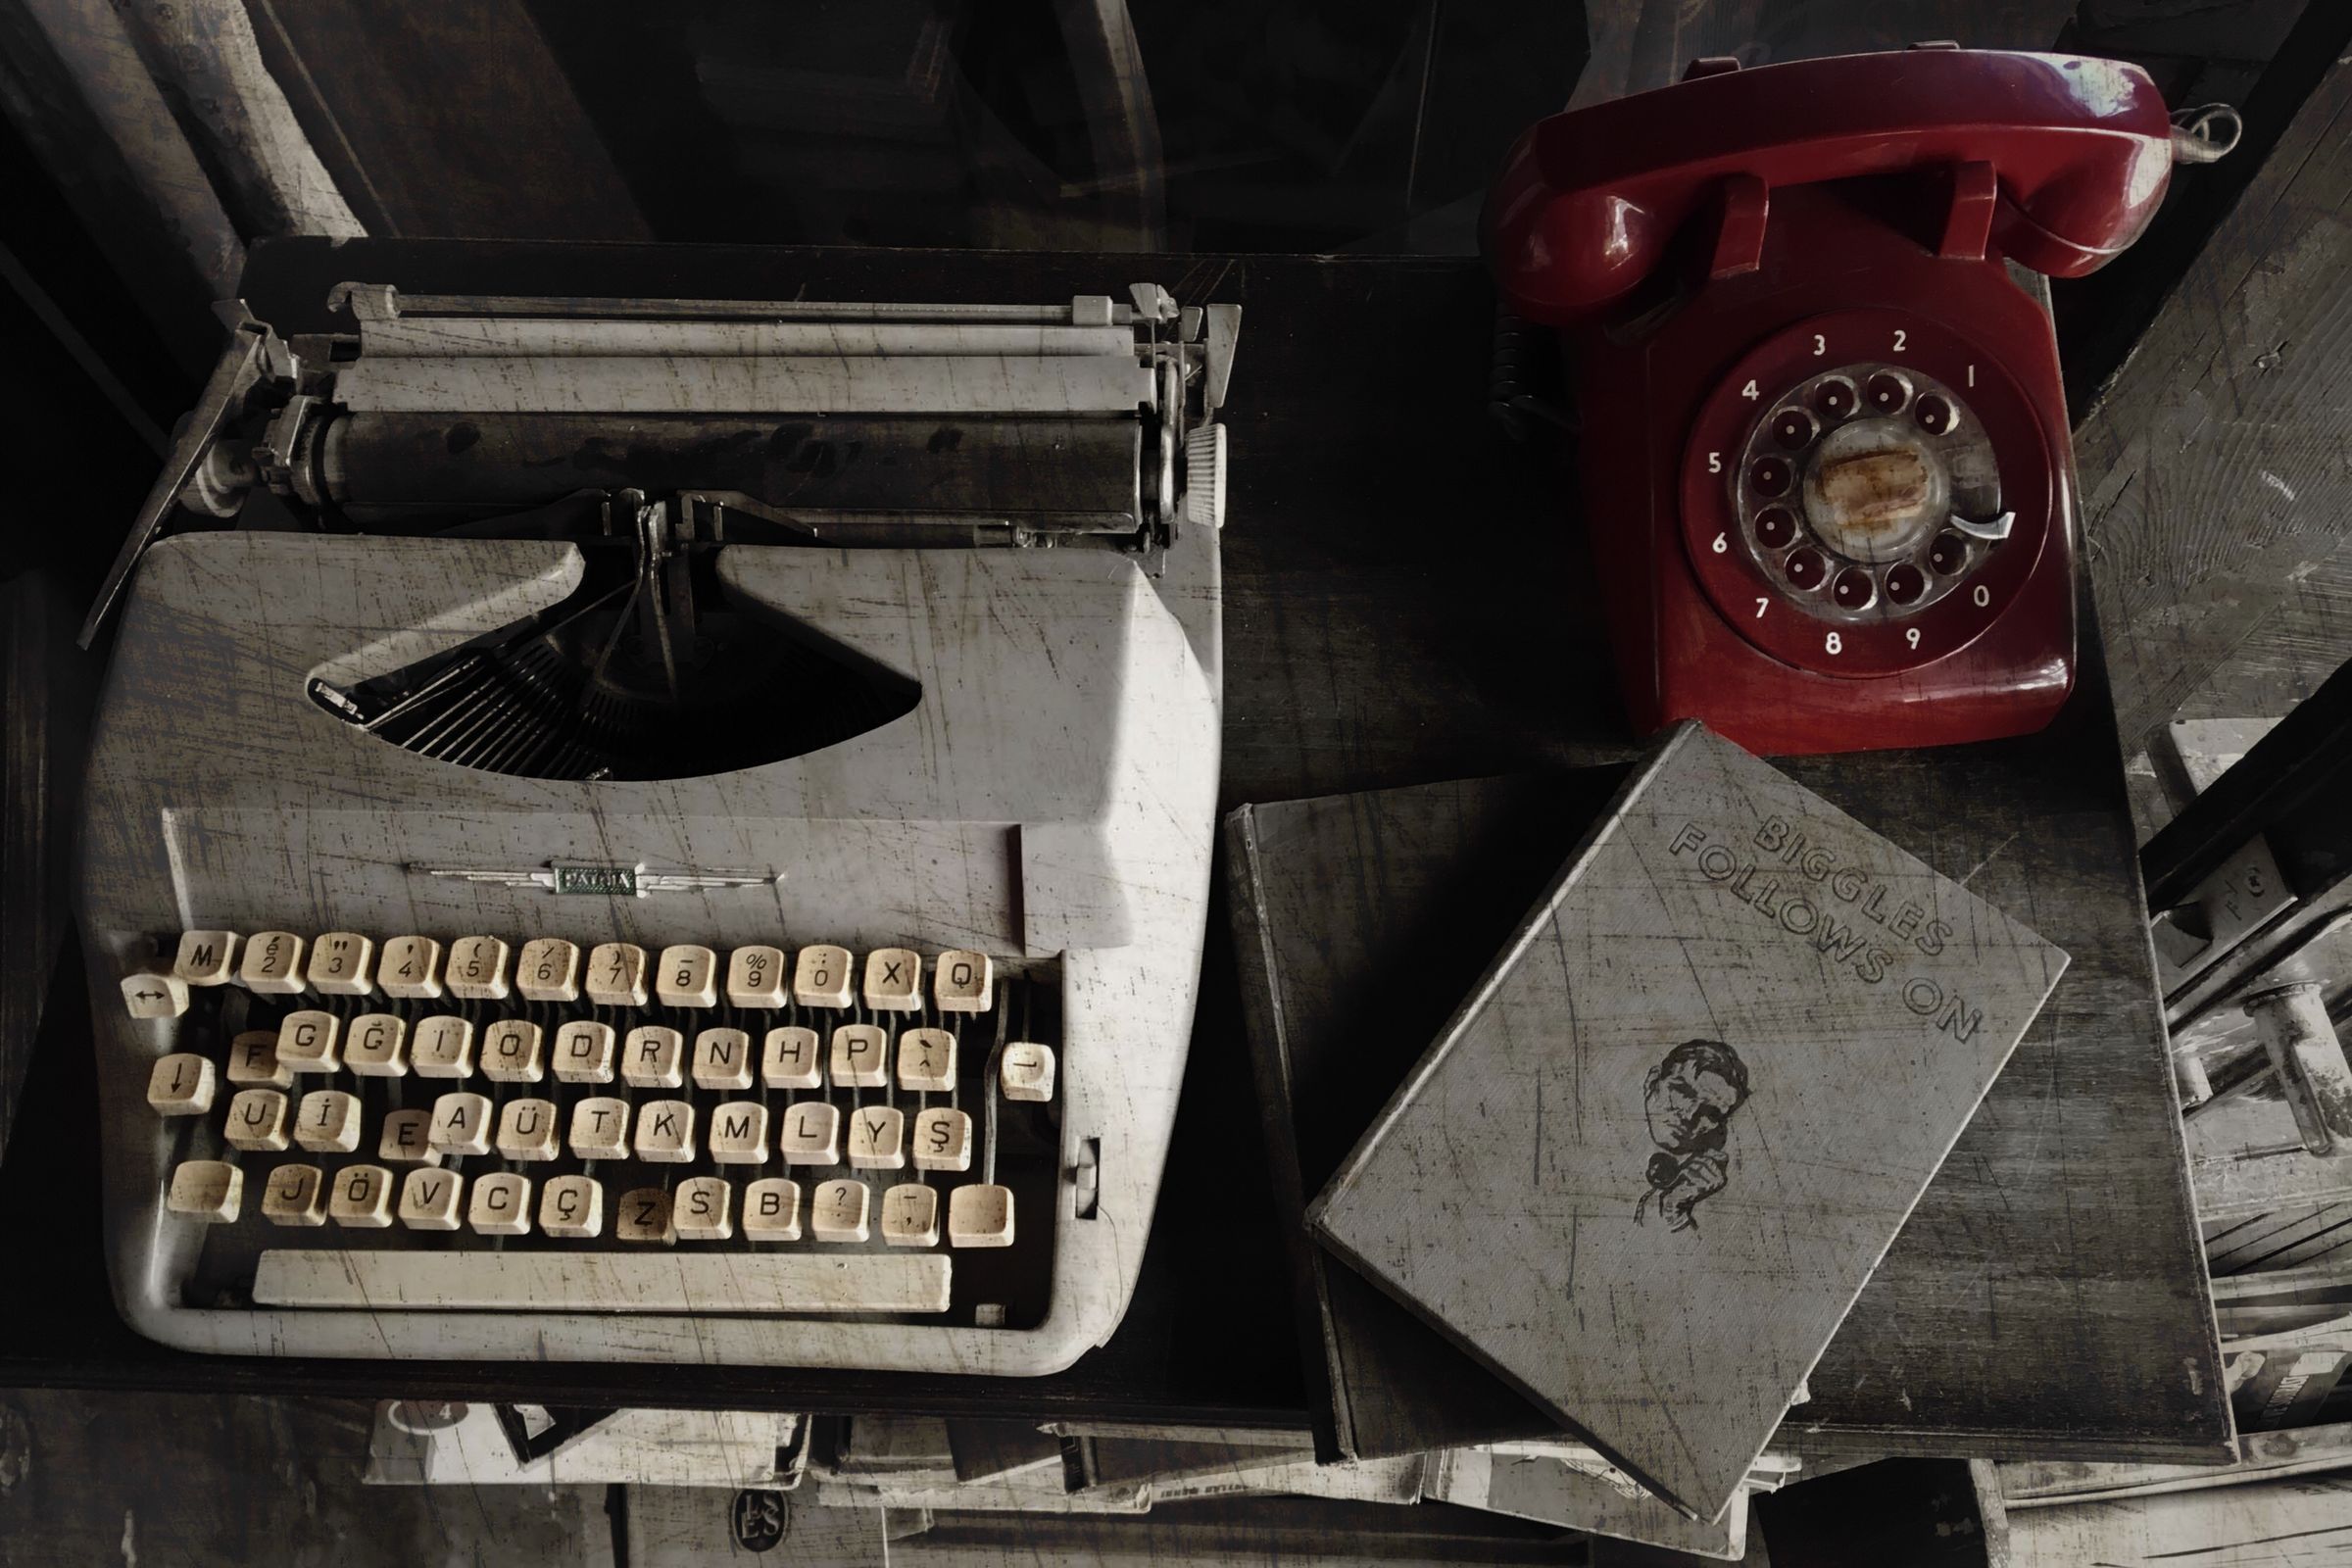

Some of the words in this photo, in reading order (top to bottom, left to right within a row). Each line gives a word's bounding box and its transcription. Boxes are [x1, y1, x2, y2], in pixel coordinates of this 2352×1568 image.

[1814, 335, 1825, 356] 3
[1893, 330, 1906, 352] 2
[1968, 365, 1975, 387] 1
[1741, 380, 1759, 401] 4
[1708, 453, 1721, 473] 5
[1712, 532, 1727, 554] 6
[1974, 585, 1989, 608] 0
[1755, 598, 1769, 618] 7
[1825, 632, 1842, 655] 8
[1906, 628, 1921, 650] 9
[1753, 814, 1953, 956] BIGGLES
[1669, 823, 1893, 984] FOLLOWS
[1902, 978, 1983, 1045] ON
[190, 945, 213, 966] M
[262, 956, 276, 972] 2
[329, 957, 343, 973] 3
[747, 954, 766, 968] %
[398, 960, 412, 977] 4
[466, 960, 480, 977] 5
[537, 962, 551, 980] 6
[610, 968, 622, 985] 7
[676, 969, 691, 986] 8
[748, 970, 761, 987] 9
[883, 962, 901, 984] X
[951, 963, 971, 988] Q
[295, 1024, 317, 1047] G
[363, 1020, 383, 1051] Ğ
[571, 1036, 592, 1057] D
[246, 1045, 266, 1067] F
[641, 1041, 661, 1062] R
[710, 1042, 731, 1064] N
[780, 1042, 800, 1062] H
[848, 1040, 868, 1060] P
[245, 1103, 266, 1125] U
[448, 1106, 466, 1128] A
[516, 1106, 537, 1134] Ü
[591, 1110, 610, 1133] T
[654, 1113, 673, 1136] K
[398, 1123, 418, 1146] E
[725, 1116, 749, 1138] M
[800, 1116, 817, 1138] L
[867, 1121, 885, 1143] Y
[931, 1121, 950, 1152] Ş
[281, 1179, 302, 1200] J
[348, 1173, 369, 1201] Ö
[422, 1182, 440, 1203] V
[835, 1187, 847, 1205] ?
[488, 1187, 508, 1210] C
[558, 1190, 577, 1220] Ç
[691, 1192, 710, 1214] S
[761, 1193, 779, 1214] B
[635, 1202, 655, 1224] Z
